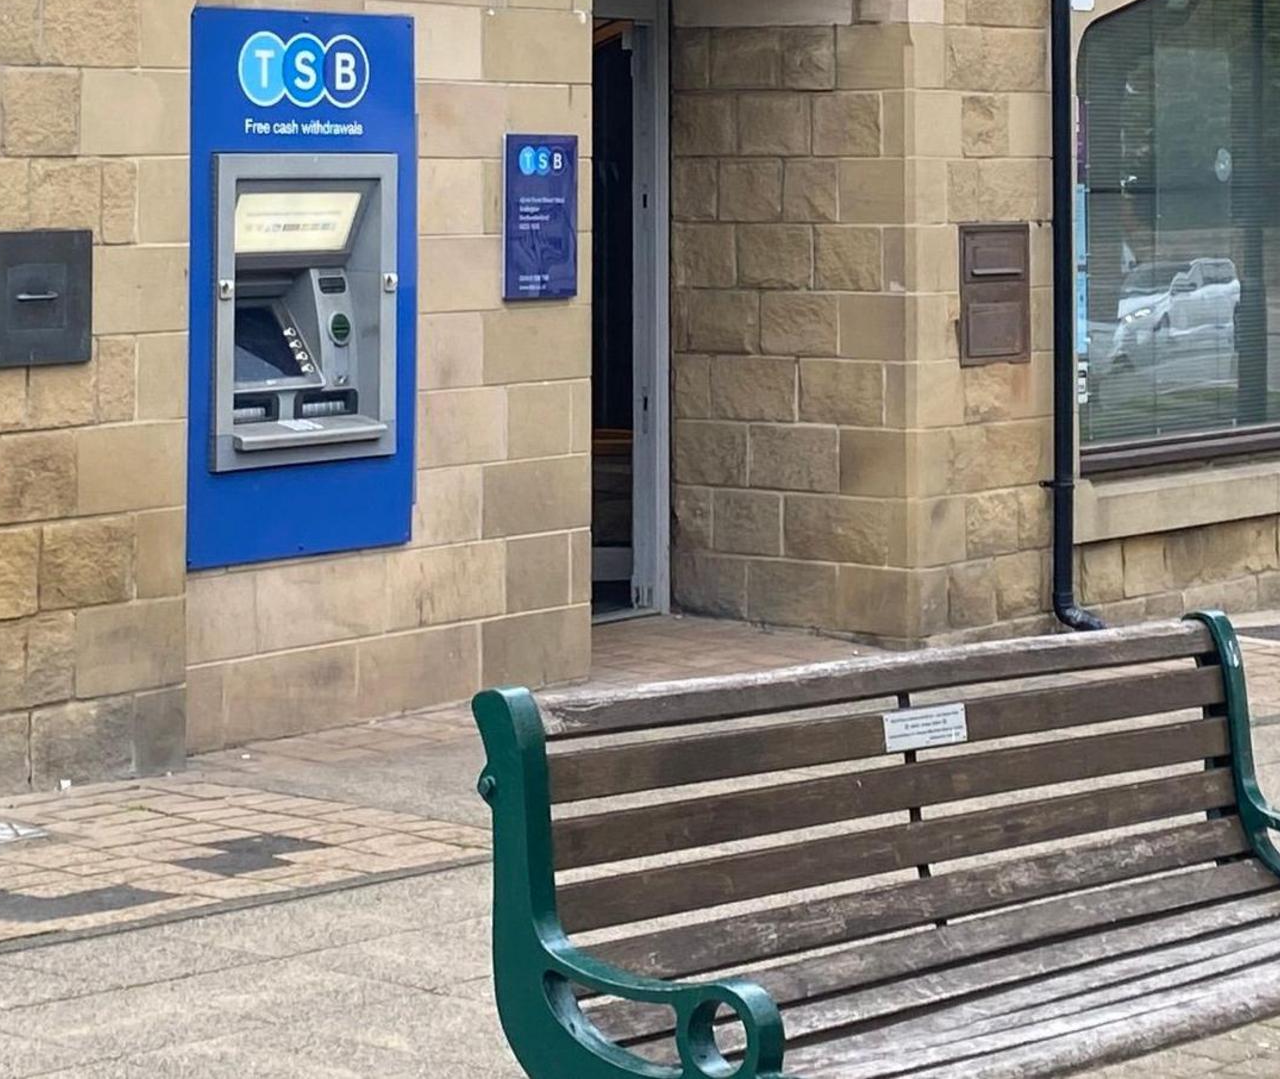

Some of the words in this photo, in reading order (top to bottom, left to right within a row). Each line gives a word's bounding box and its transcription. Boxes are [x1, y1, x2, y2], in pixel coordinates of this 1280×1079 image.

[254, 49, 357, 91] TSB
[245, 118, 271, 134] Free
[273, 118, 299, 134] cash
[301, 120, 364, 136] withdrawals
[524, 152, 562, 170] TSB
